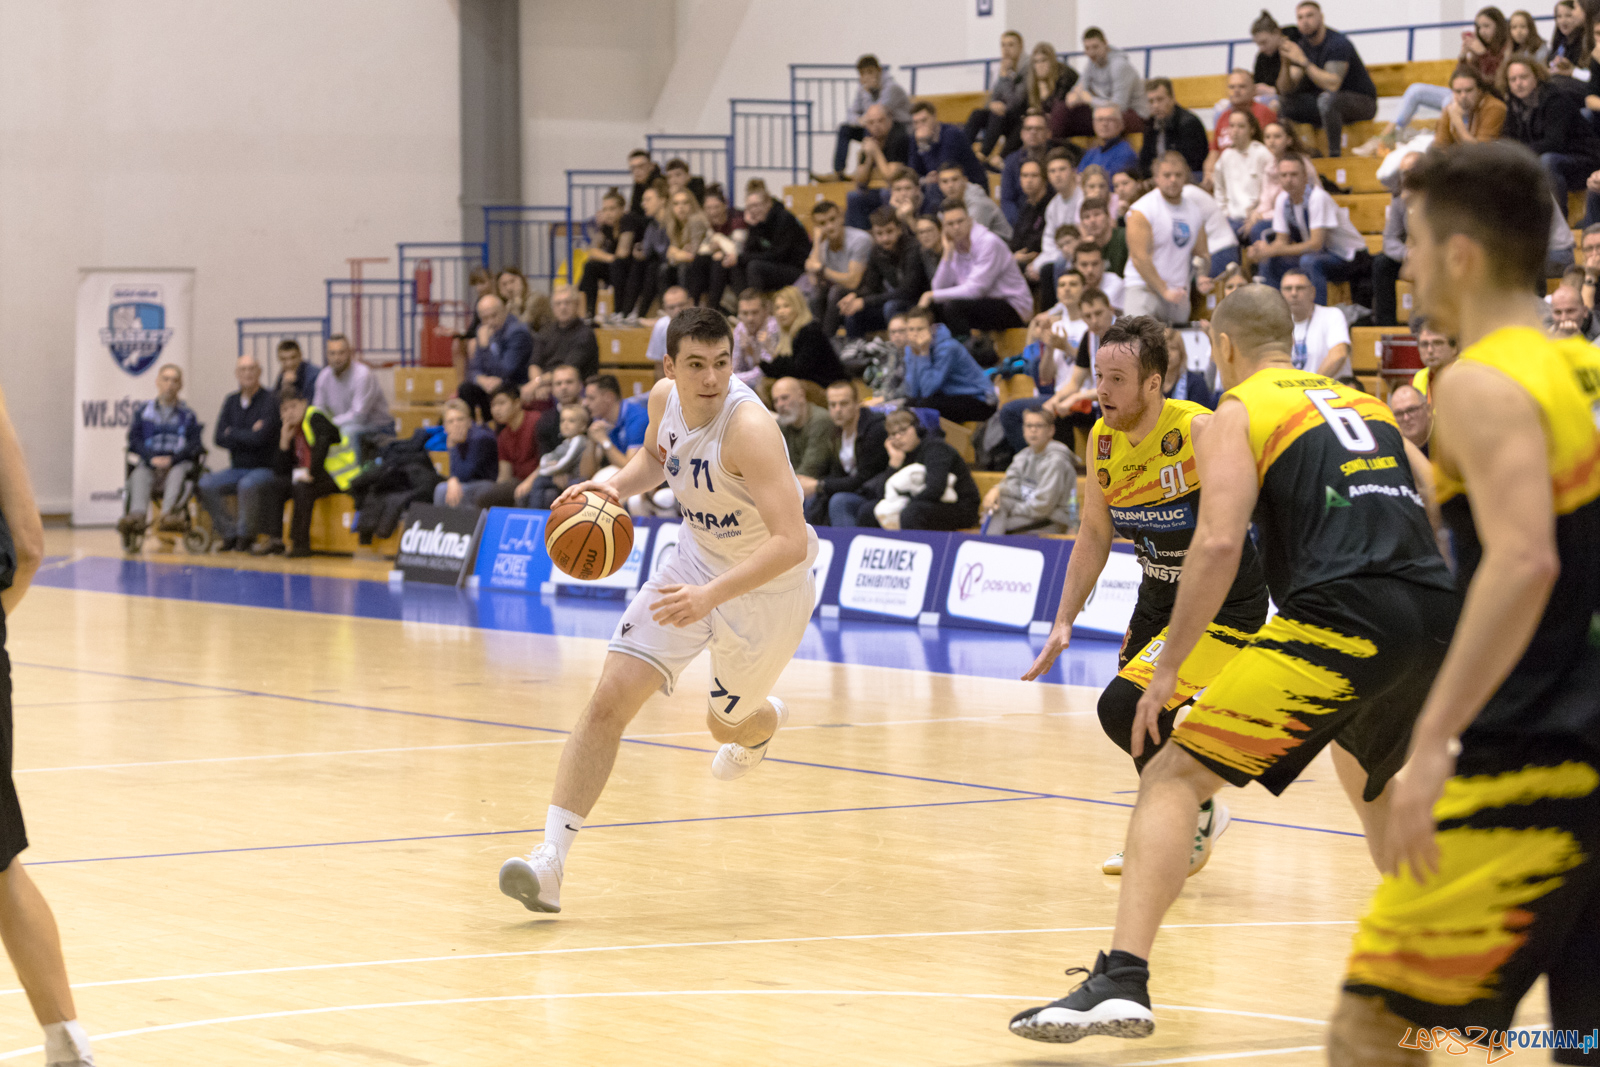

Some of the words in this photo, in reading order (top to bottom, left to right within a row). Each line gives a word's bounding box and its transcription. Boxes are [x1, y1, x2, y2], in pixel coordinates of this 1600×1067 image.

[1303, 388, 1379, 454] 6
[690, 458, 715, 493] 71
[1160, 460, 1189, 499] 91
[491, 553, 531, 577] HOTEL
[860, 547, 918, 571] HELMEX
[855, 572, 912, 590] EXHIBITIONS
[981, 578, 1032, 594] posnania
[1139, 639, 1166, 668] 9
[710, 676, 741, 715] 71
